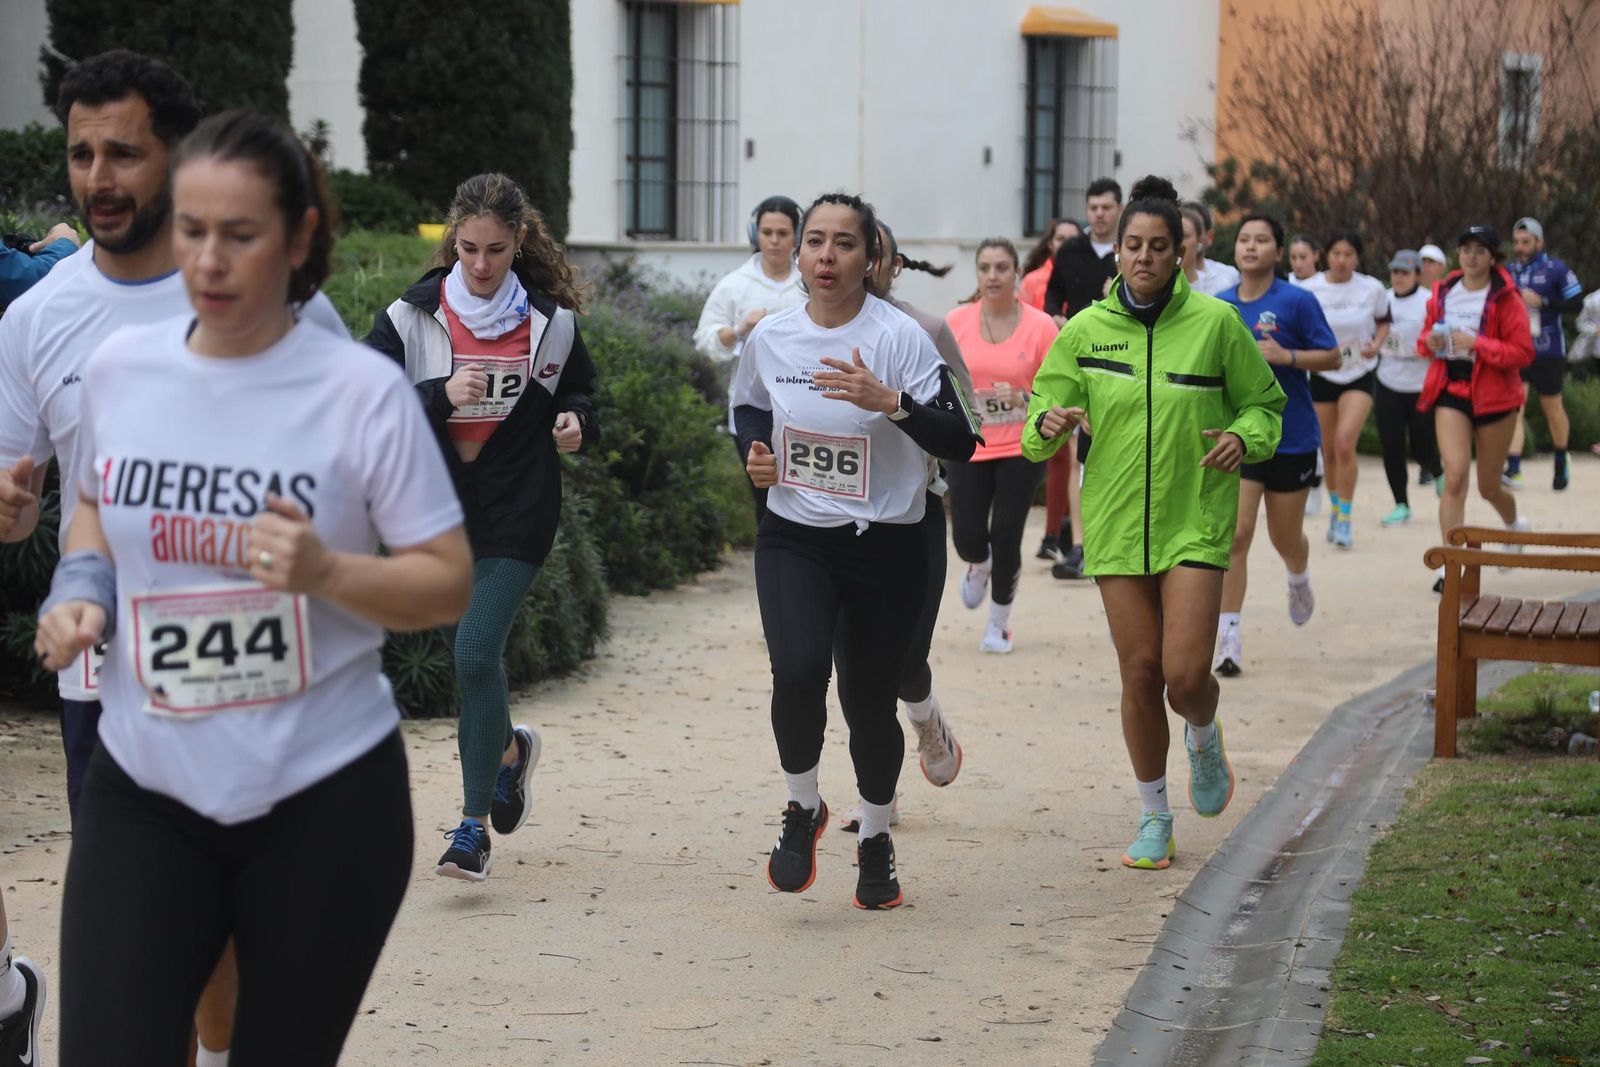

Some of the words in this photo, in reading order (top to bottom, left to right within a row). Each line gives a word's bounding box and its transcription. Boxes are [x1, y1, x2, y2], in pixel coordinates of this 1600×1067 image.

[1091, 341, 1129, 353] luanvi
[544, 363, 561, 373] NIKE
[785, 375, 815, 385] Interna
[485, 373, 522, 399] 12
[790, 442, 860, 476] 296
[102, 456, 317, 520] LIDERESAS
[151, 615, 288, 671] 244
